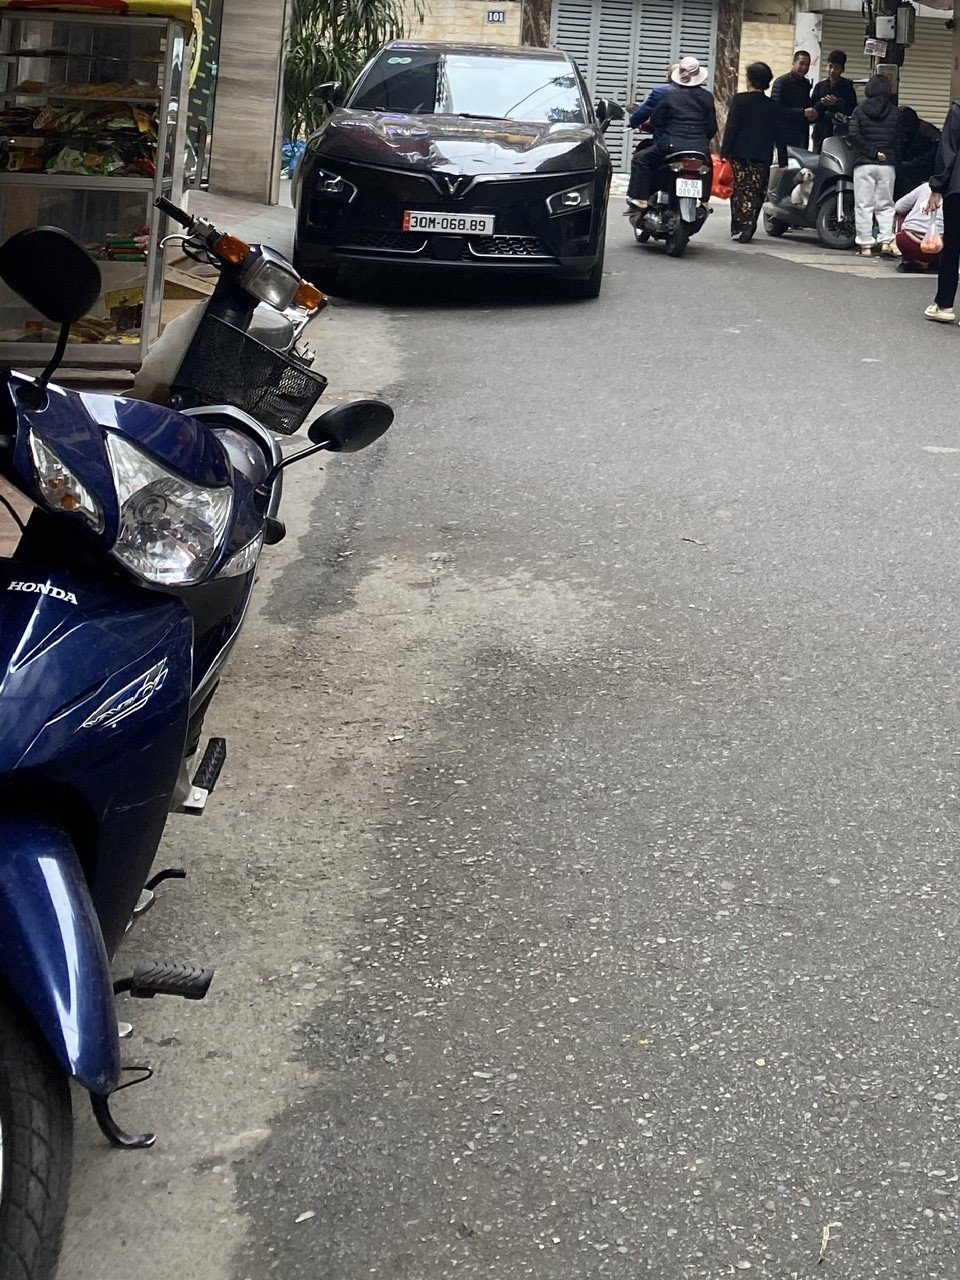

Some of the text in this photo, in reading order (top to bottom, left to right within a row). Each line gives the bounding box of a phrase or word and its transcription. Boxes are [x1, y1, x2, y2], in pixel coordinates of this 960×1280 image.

[488, 12, 504, 21] 101
[410, 216, 486, 231] 30M-068.89
[7, 581, 78, 605] HONDA
